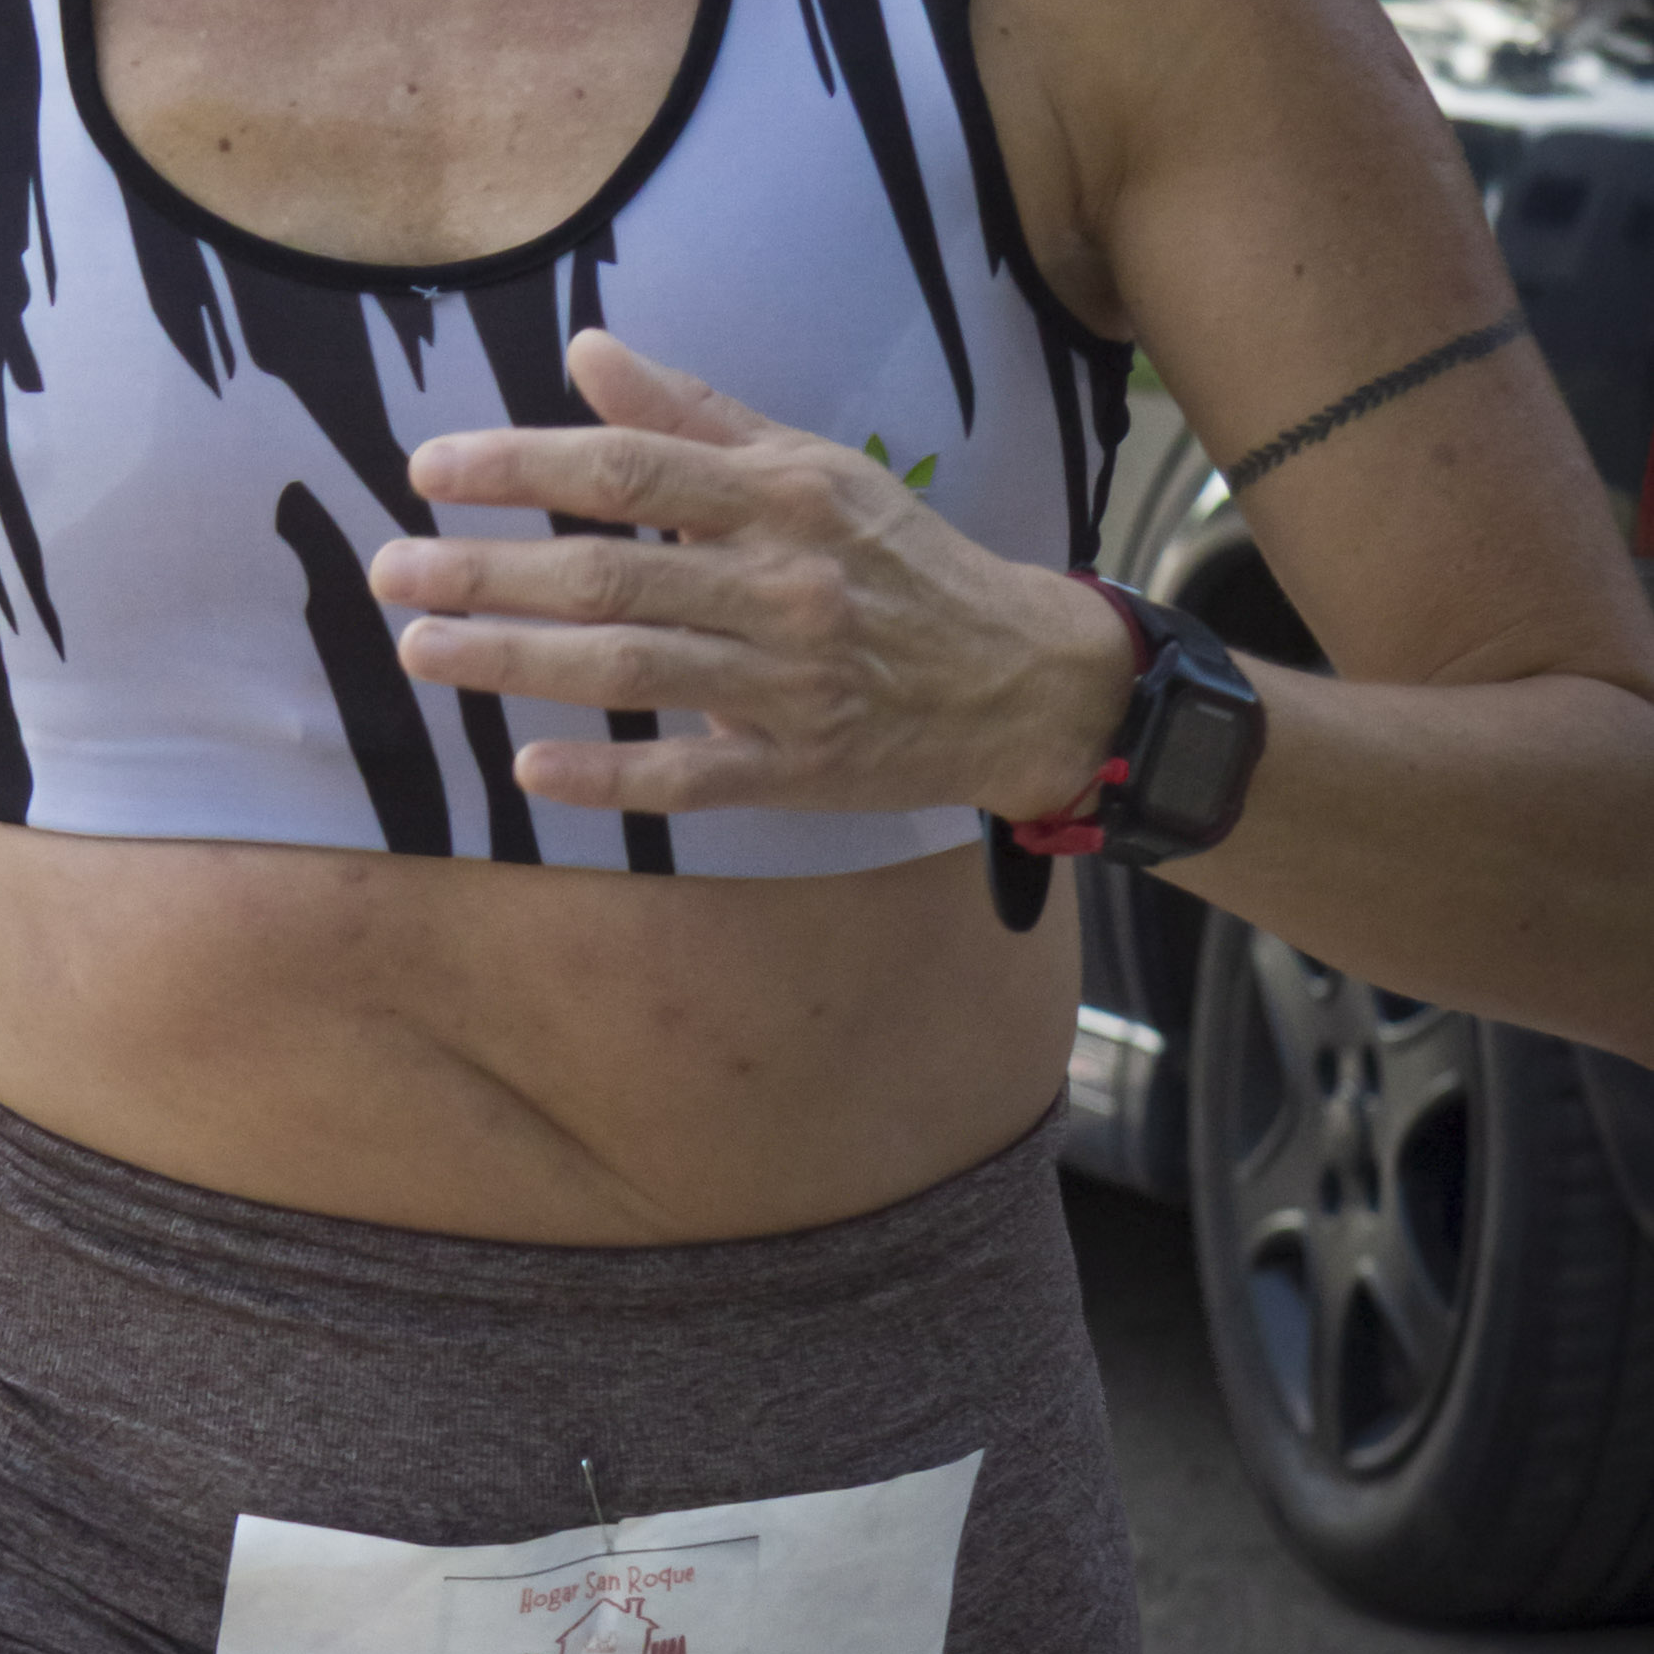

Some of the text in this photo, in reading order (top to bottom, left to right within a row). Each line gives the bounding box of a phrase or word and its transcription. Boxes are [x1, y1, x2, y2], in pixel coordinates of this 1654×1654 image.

[519, 1566, 696, 1614] Hogar San Roque
